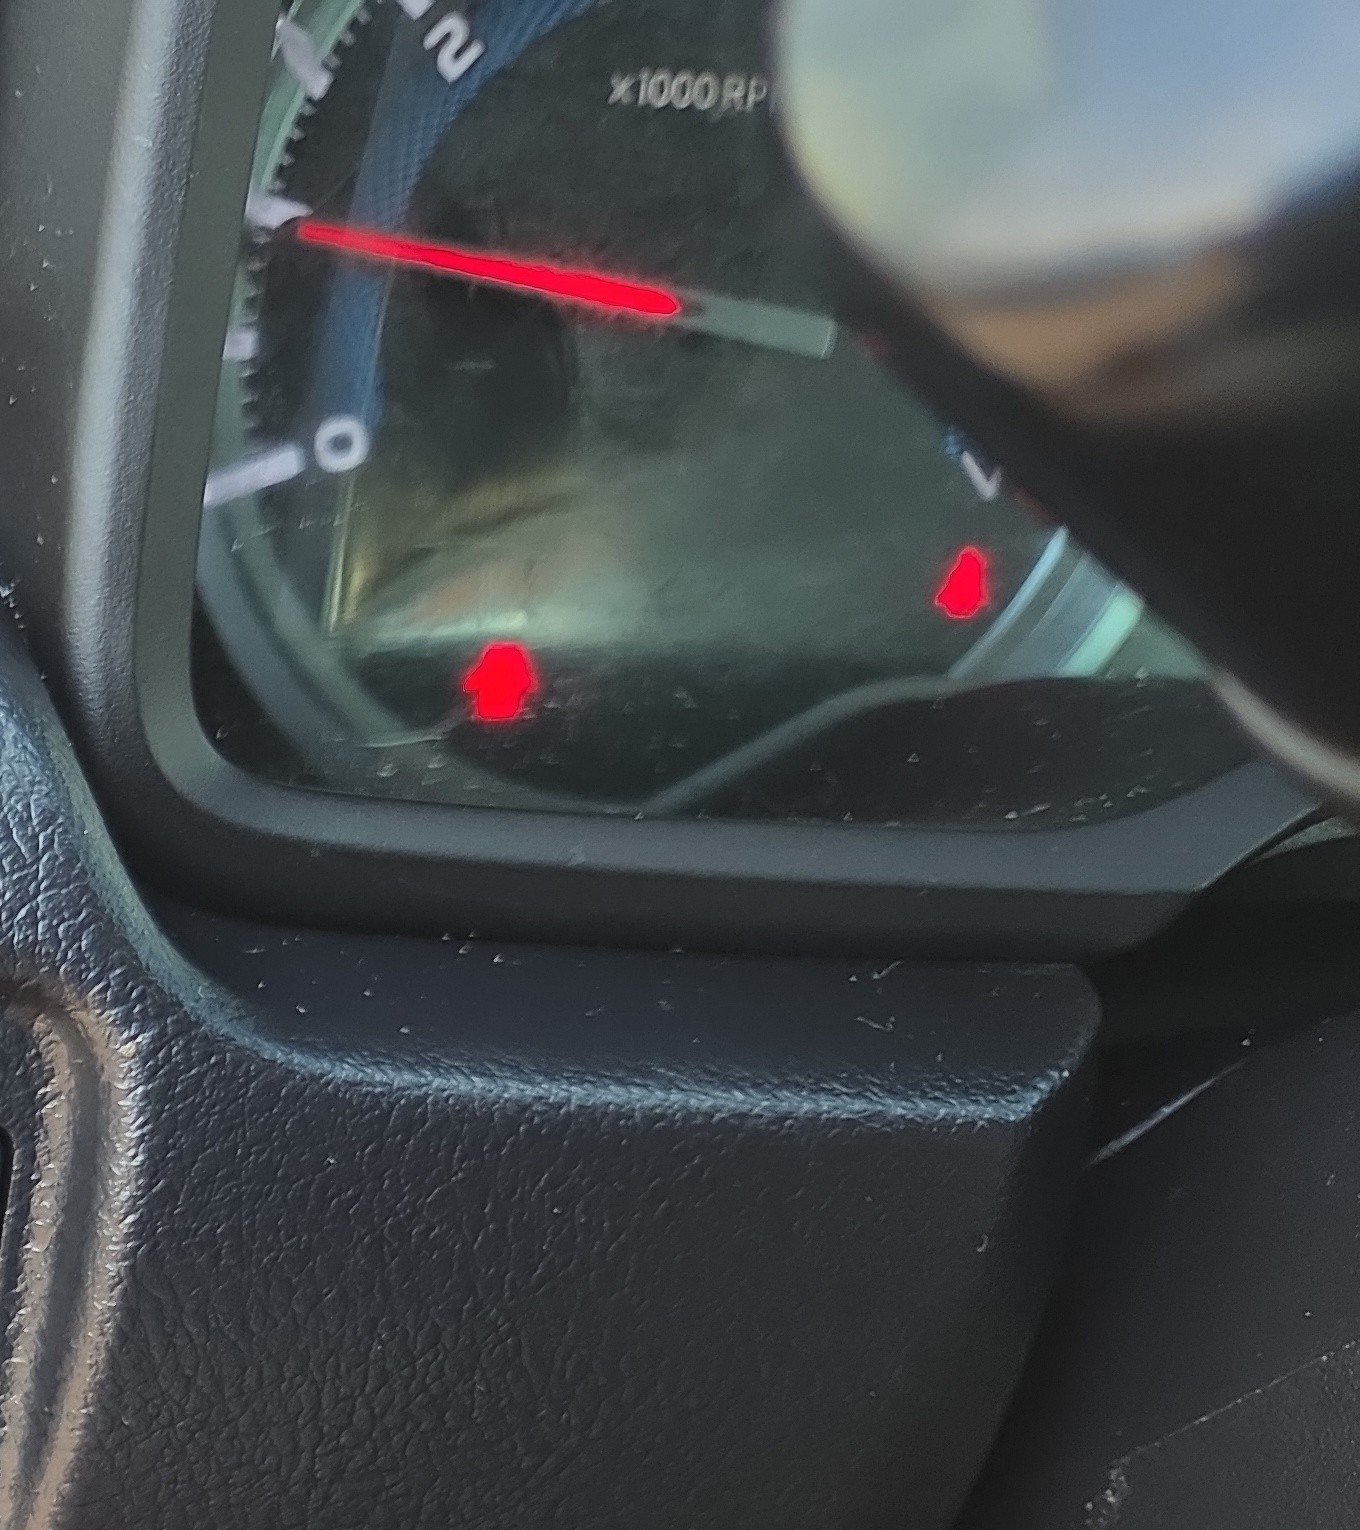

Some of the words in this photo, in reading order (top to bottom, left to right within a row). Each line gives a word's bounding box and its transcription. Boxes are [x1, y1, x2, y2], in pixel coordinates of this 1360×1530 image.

[423, 10, 485, 84] 2
[721, 72, 775, 113] RP
[314, 414, 369, 474] 0
